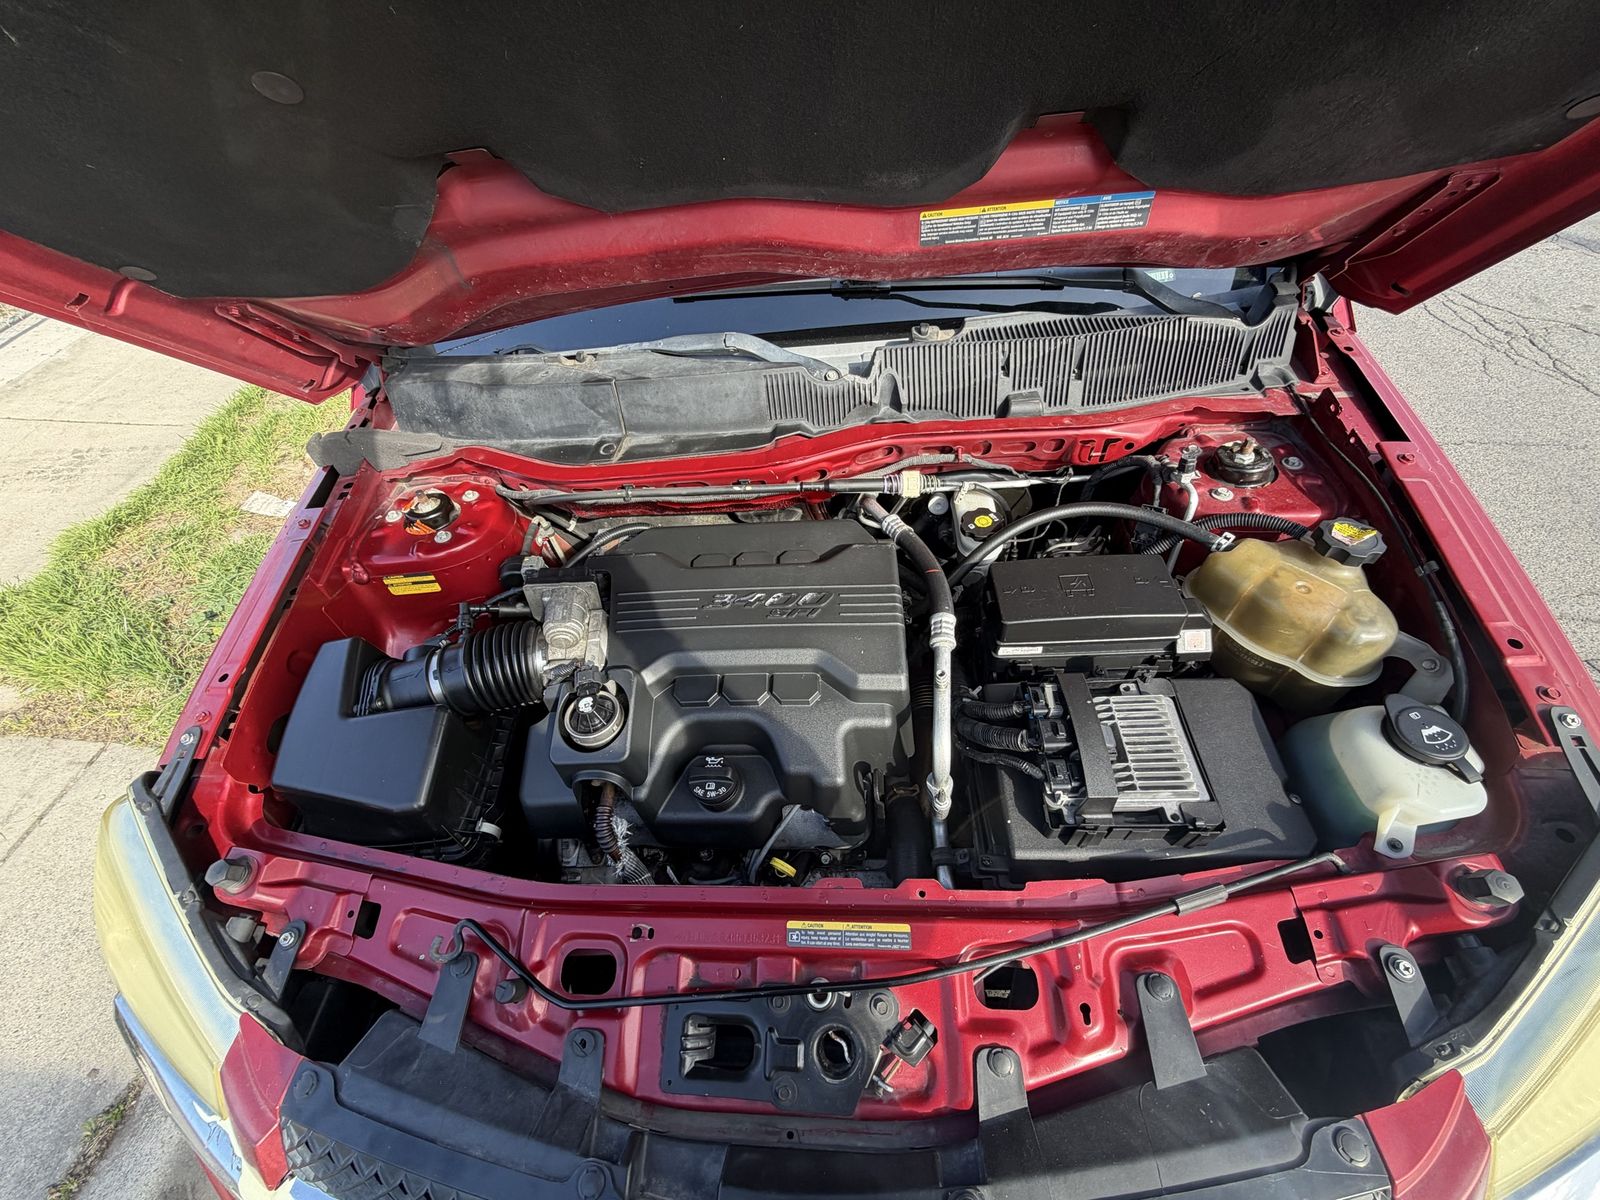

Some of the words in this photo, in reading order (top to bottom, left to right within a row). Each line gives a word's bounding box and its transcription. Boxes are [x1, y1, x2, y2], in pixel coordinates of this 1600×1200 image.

[702, 592, 833, 609] 3400
[693, 786, 705, 797] SAE
[706, 786, 727, 798] 5W-30
